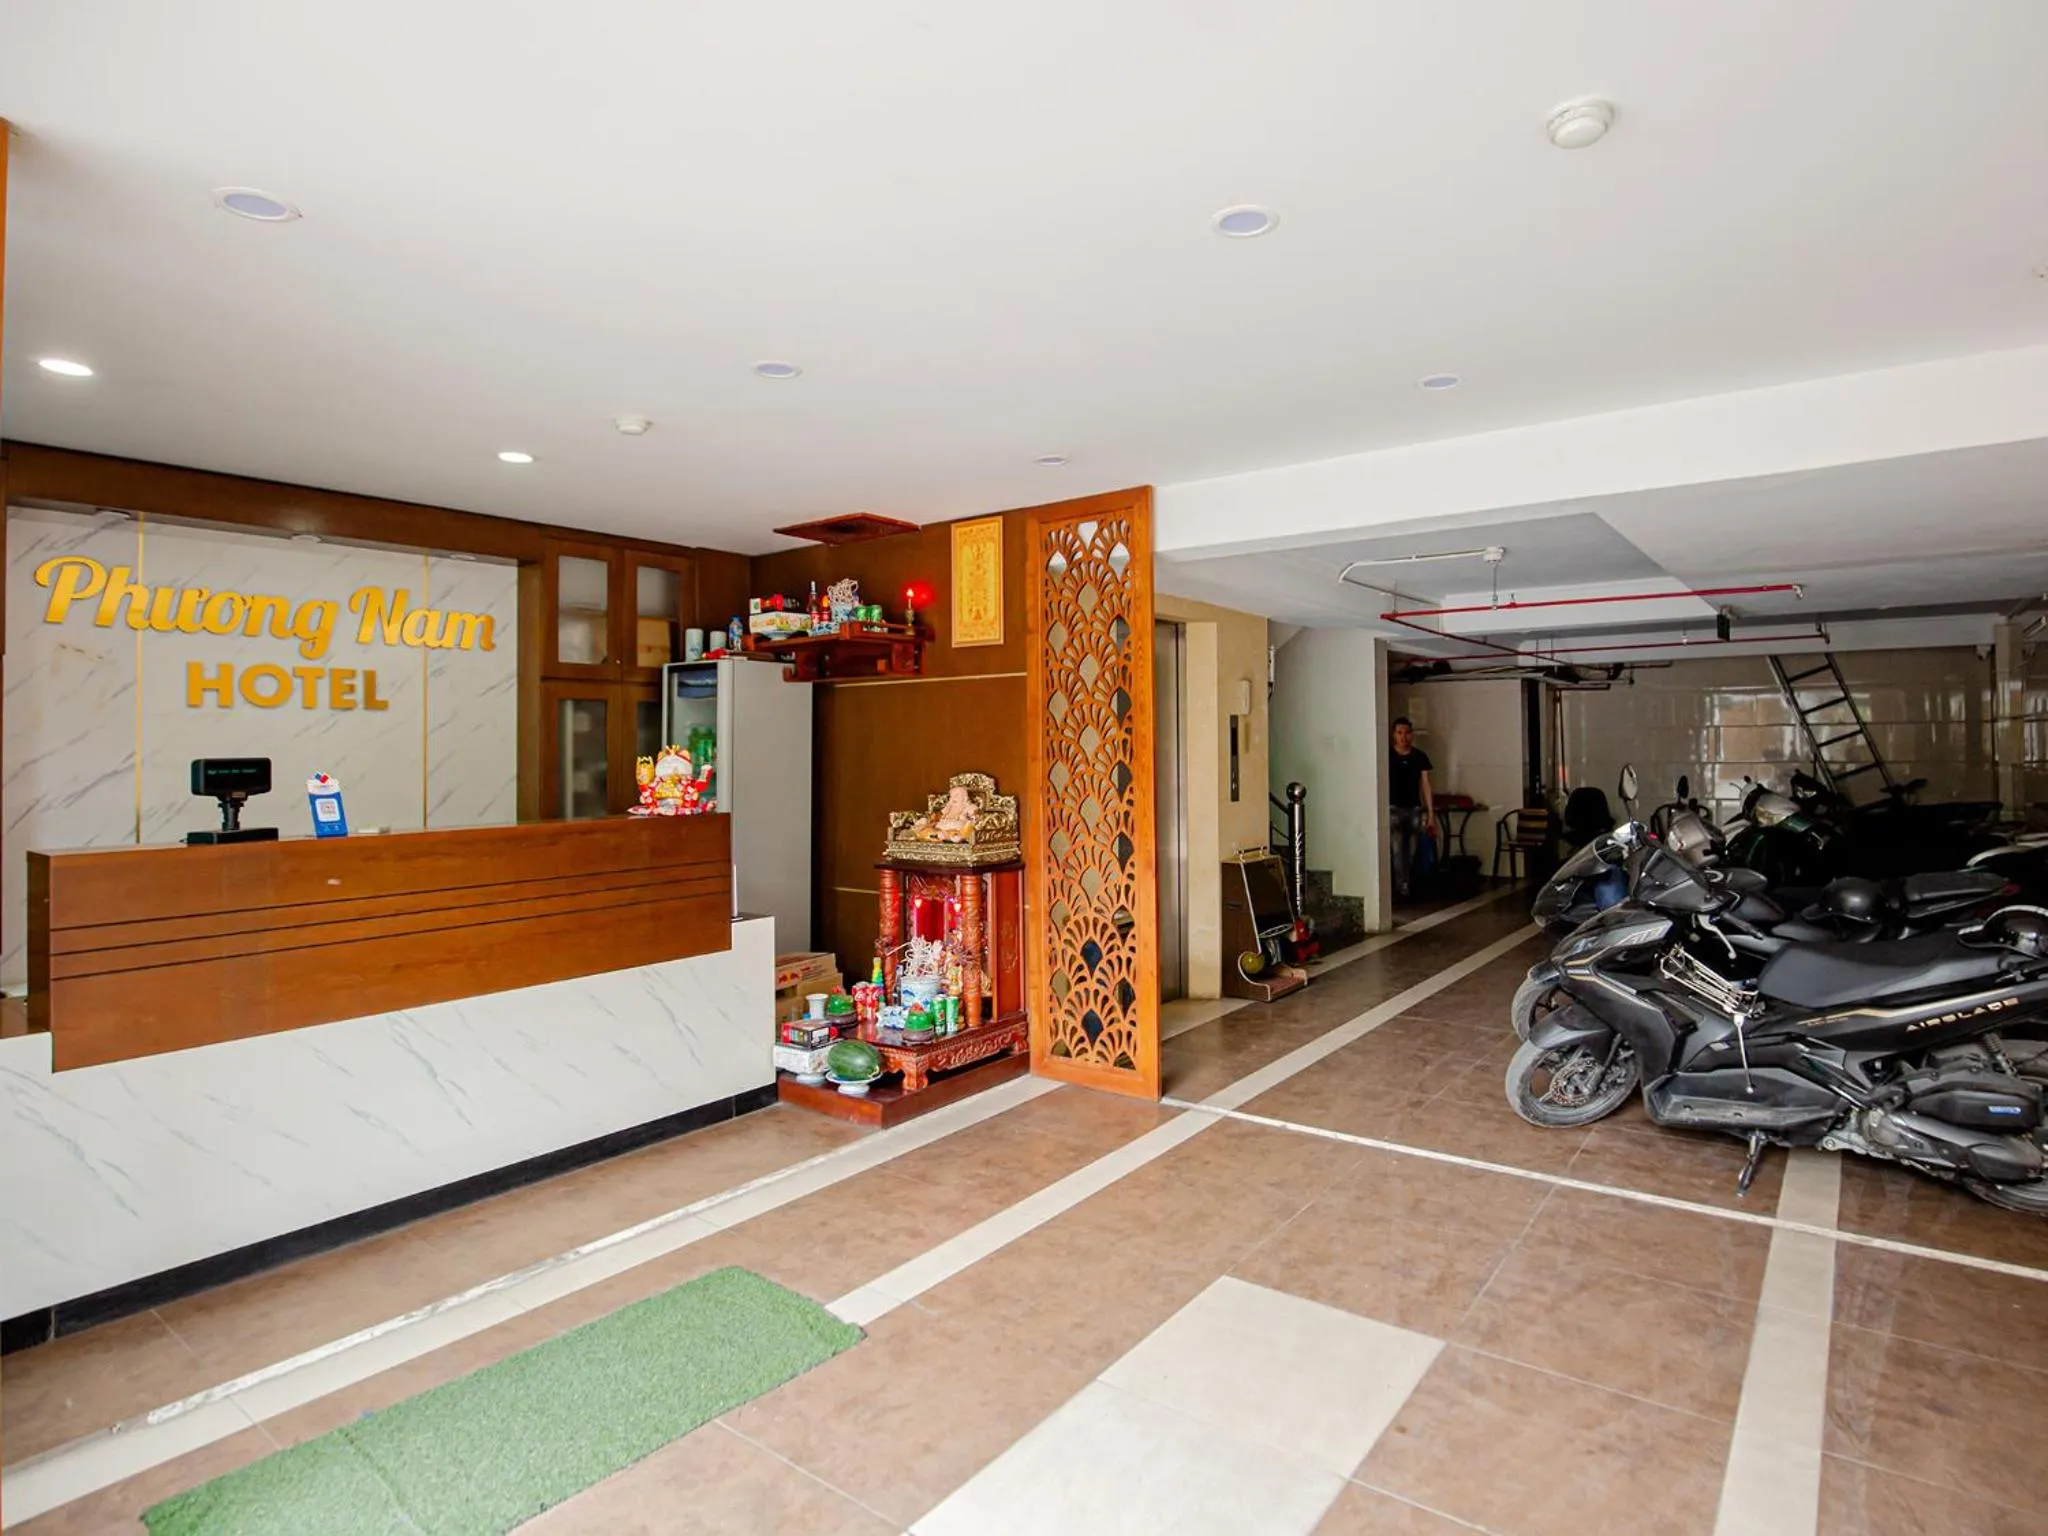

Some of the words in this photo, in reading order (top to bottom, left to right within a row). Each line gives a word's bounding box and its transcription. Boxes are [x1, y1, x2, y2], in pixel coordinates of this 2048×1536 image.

[34, 556, 339, 659] Phương
[349, 585, 496, 651] Nam
[186, 661, 389, 711] HOTEL
